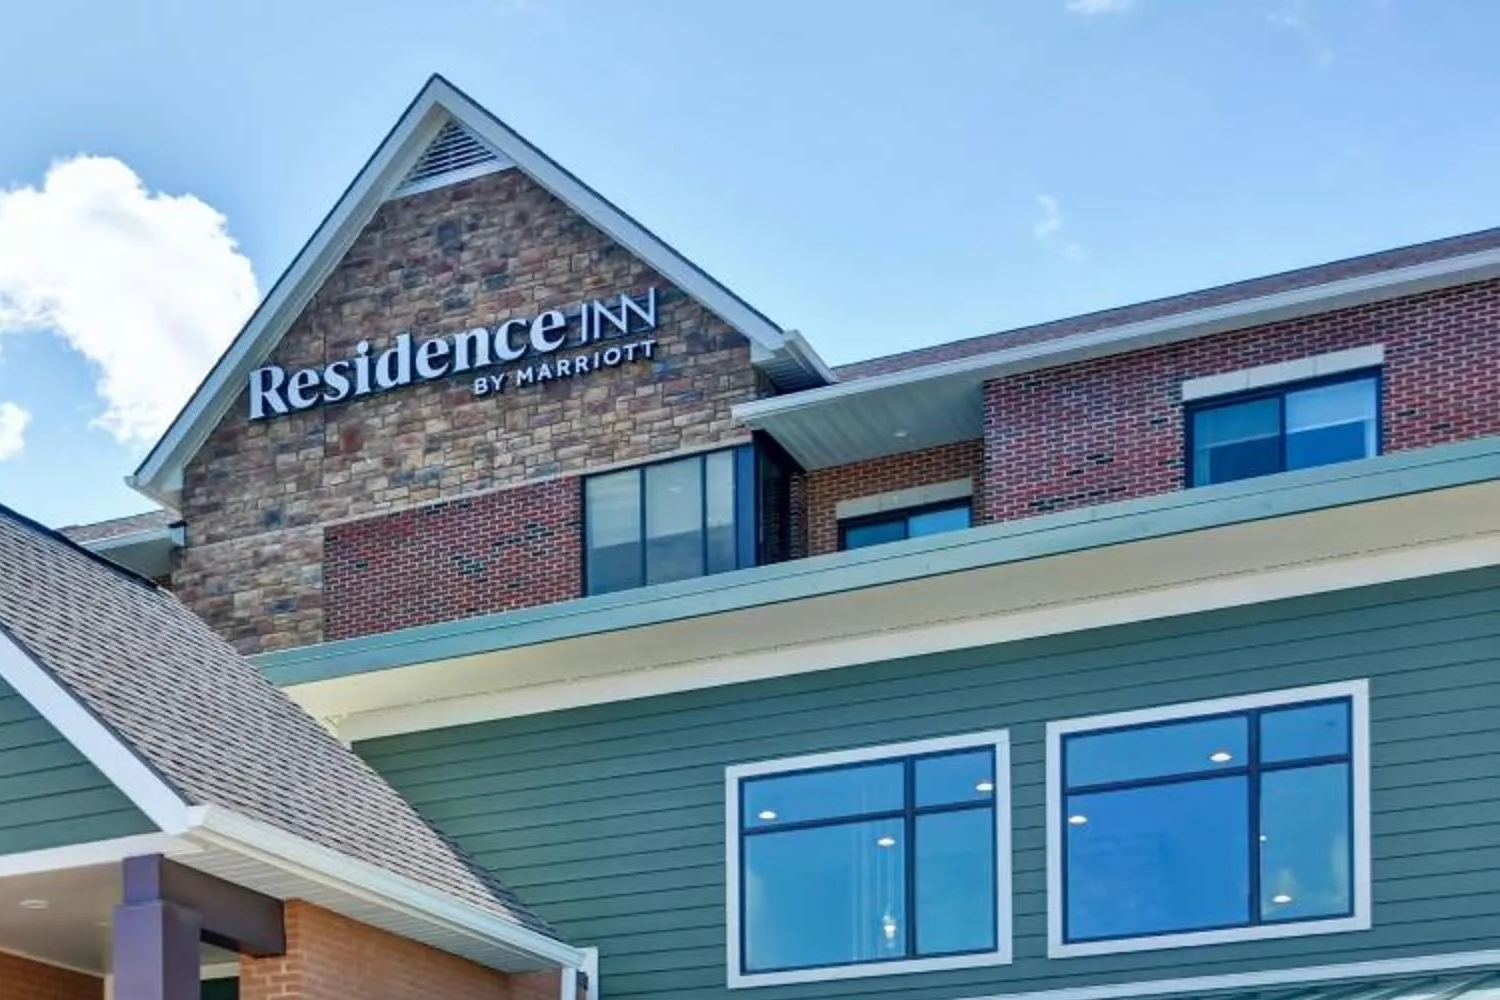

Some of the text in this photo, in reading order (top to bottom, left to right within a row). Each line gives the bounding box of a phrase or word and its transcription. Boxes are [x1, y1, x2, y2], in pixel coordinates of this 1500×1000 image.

[249, 286, 656, 420] Residence INN
[473, 339, 657, 396] BY MARRIOTT
